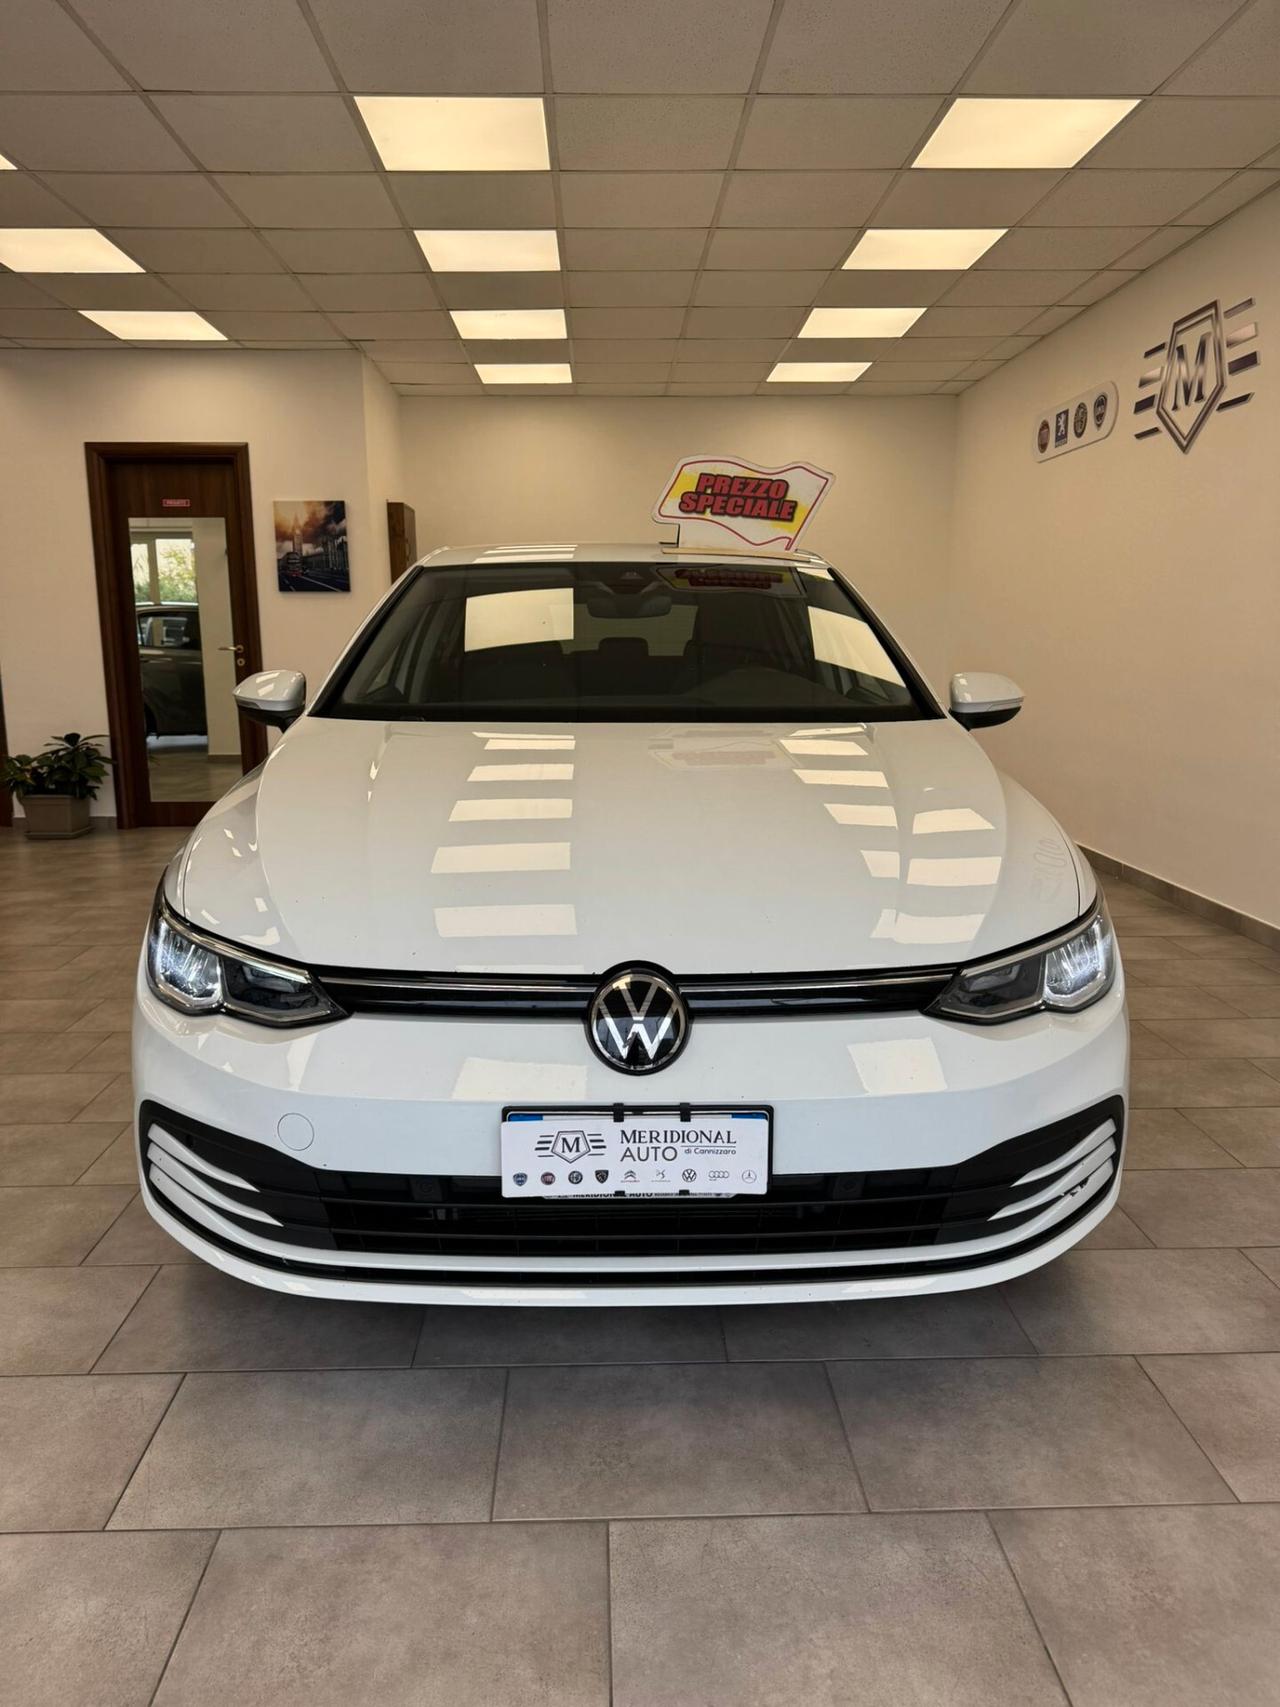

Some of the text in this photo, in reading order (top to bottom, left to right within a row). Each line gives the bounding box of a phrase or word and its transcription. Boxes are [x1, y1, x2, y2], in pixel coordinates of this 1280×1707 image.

[1171, 331, 1212, 412] M
[695, 473, 790, 499] PREZZO
[679, 492, 798, 522] SPECIALE
[561, 1136, 581, 1153] M
[620, 1129, 737, 1144] MERIDIONAL
[620, 1146, 678, 1162] AUTO
